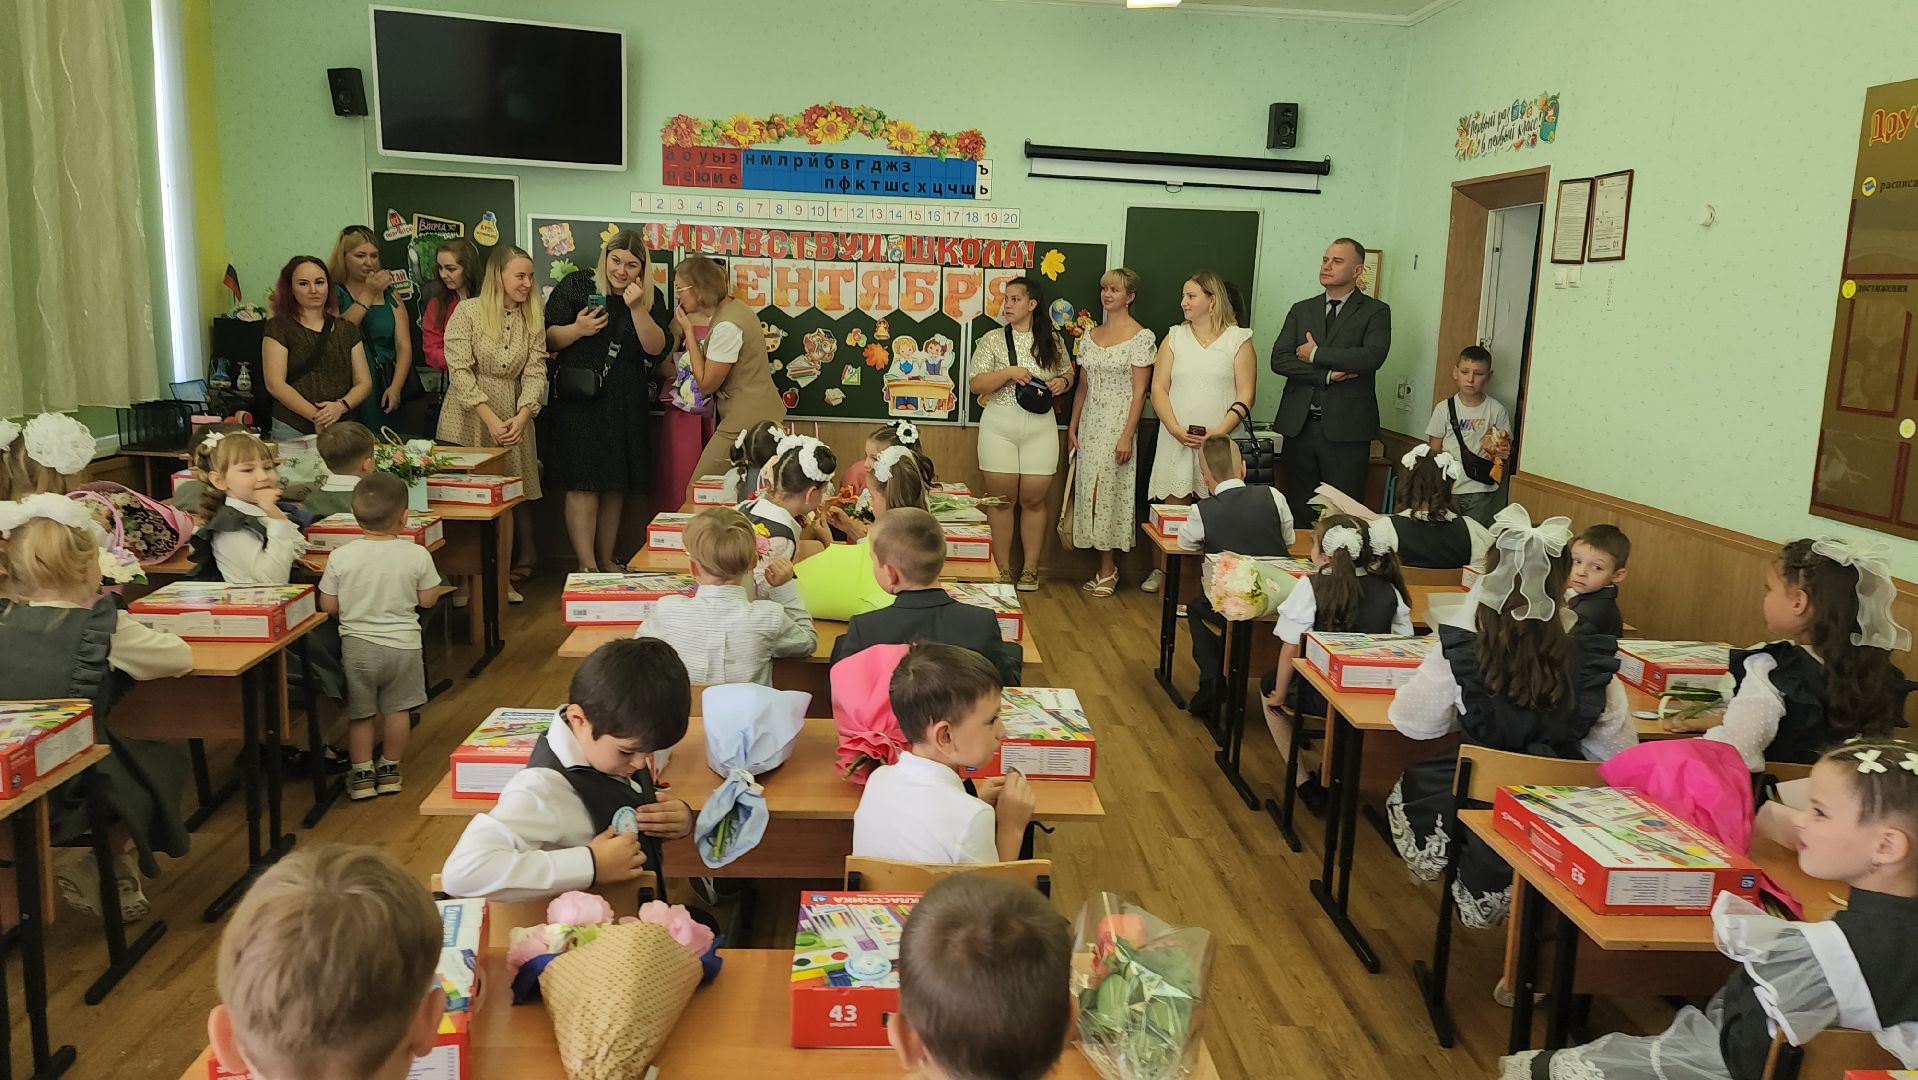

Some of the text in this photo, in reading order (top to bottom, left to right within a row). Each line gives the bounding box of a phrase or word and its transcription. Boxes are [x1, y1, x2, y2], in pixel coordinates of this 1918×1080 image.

[1868, 105, 1918, 146] Дру
[700, 152, 708, 164] у
[712, 152, 726, 162] ы
[730, 153, 738, 164] э
[746, 154, 755, 165] н
[760, 154, 772, 166] м
[778, 155, 788, 166] л
[794, 156, 804, 171] р
[808, 152, 818, 168] й
[824, 154, 834, 169] б
[840, 159, 850, 169] в
[856, 160, 864, 170] г
[870, 160, 882, 174] д
[886, 160, 898, 172] ж
[902, 162, 912, 172] з
[978, 164, 988, 175] ъ
[730, 173, 738, 184] е
[824, 178, 834, 188] п
[838, 176, 850, 194] ф
[856, 180, 865, 190] к
[870, 180, 880, 191] т
[884, 181, 898, 192] ш
[902, 182, 910, 192] с
[917, 182, 927, 193] х
[932, 183, 942, 196] ц
[948, 184, 958, 194] ч
[962, 184, 976, 198] щ
[980, 184, 988, 195] ь
[656, 198, 664, 210] 2
[677, 198, 684, 210] 3
[696, 200, 704, 211] 4
[716, 200, 724, 212] 5
[736, 202, 744, 212] 6
[756, 202, 764, 214] 7
[776, 204, 784, 214] 8
[795, 204, 802, 216] 9
[810, 206, 824, 216] 10
[850, 208, 864, 218] 12
[870, 208, 883, 220] 13
[889, 210, 902, 220] 14
[908, 210, 922, 220] 15
[928, 210, 940, 222] 16
[946, 212, 960, 222] 17
[966, 212, 979, 222] 18
[984, 212, 998, 224] 19
[1004, 213, 1018, 224] 20
[904, 234, 1035, 269] ШКОЛА!
[733, 263, 1011, 317] ЕНТЯБРЯ
[829, 1004, 858, 1022] 43
